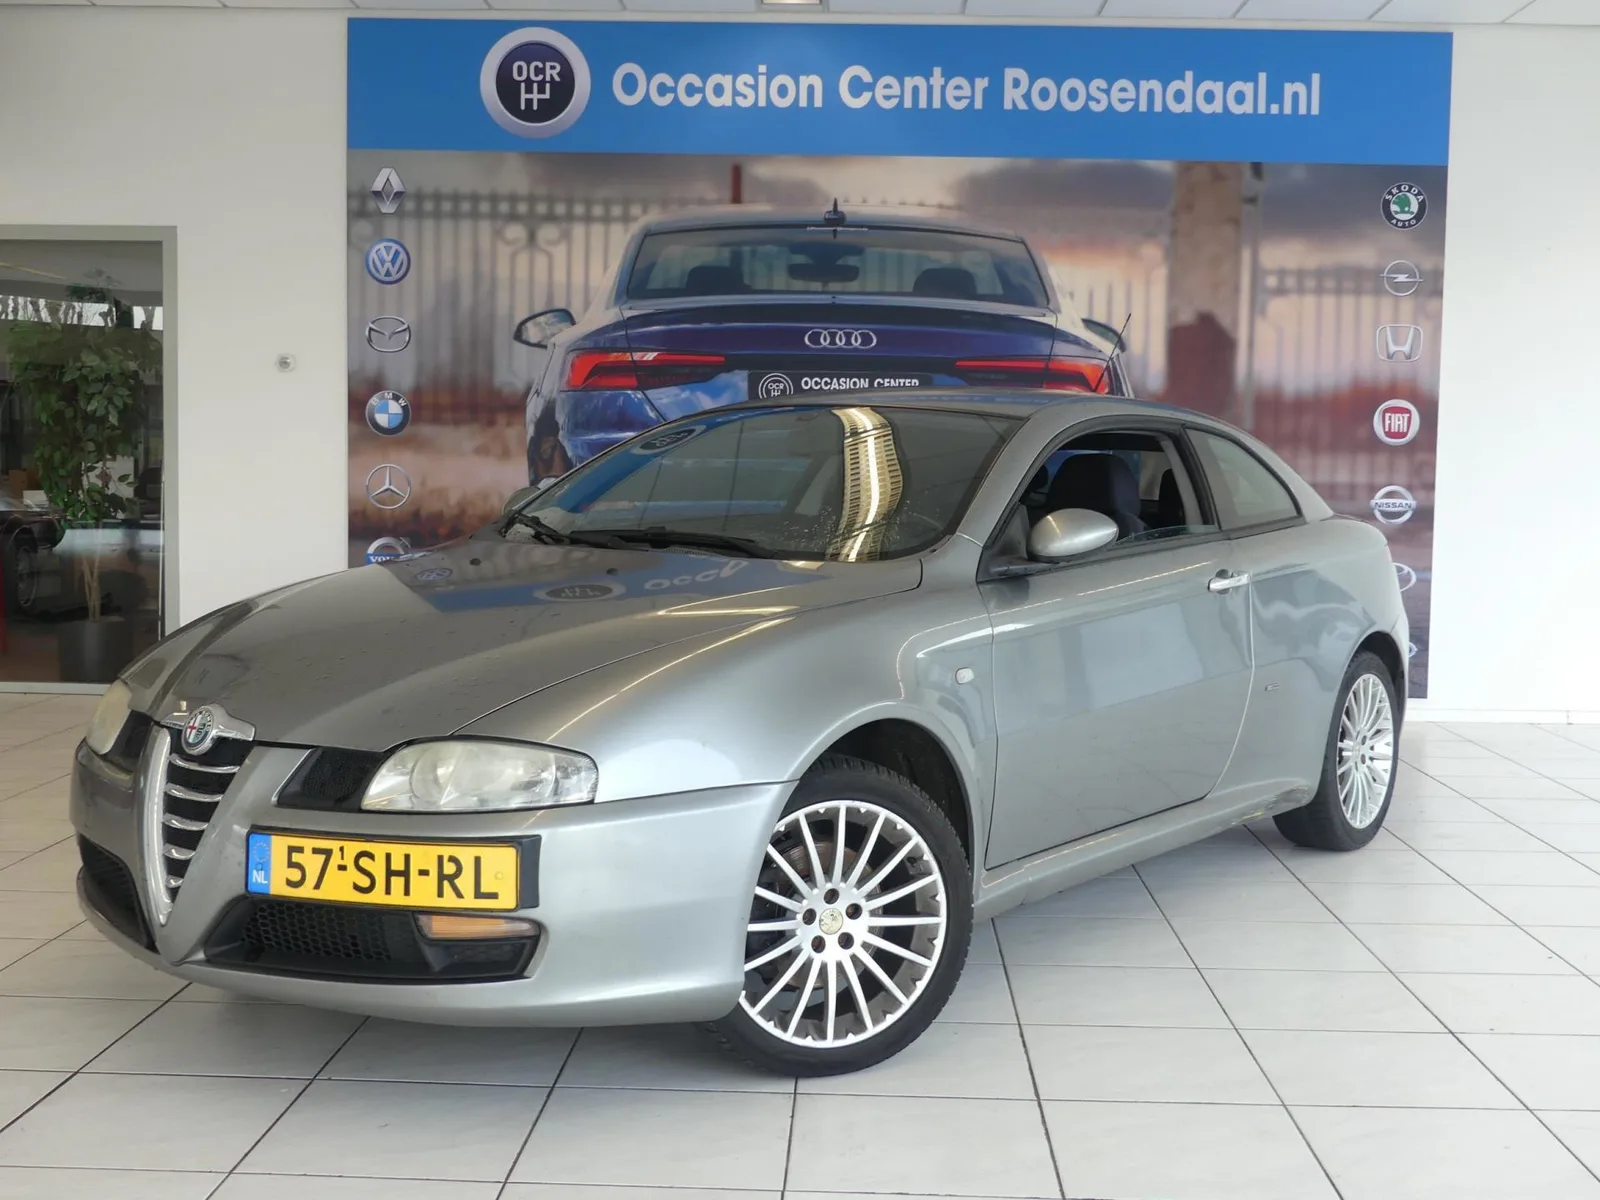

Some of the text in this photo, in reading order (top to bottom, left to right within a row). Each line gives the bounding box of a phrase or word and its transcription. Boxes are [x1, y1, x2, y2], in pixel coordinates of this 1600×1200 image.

[512, 60, 561, 83] OCR
[612, 62, 1321, 115] Occasion Center Roosendaal.nl
[1385, 184, 1424, 203] SKODA
[1391, 218, 1417, 227] AUTO
[767, 382, 784, 390] OCR
[801, 377, 869, 391] OCCASION
[371, 392, 407, 408] BMW
[1384, 412, 1411, 433] FIAT
[1374, 501, 1412, 509] NISSAN
[252, 869, 269, 884] NL
